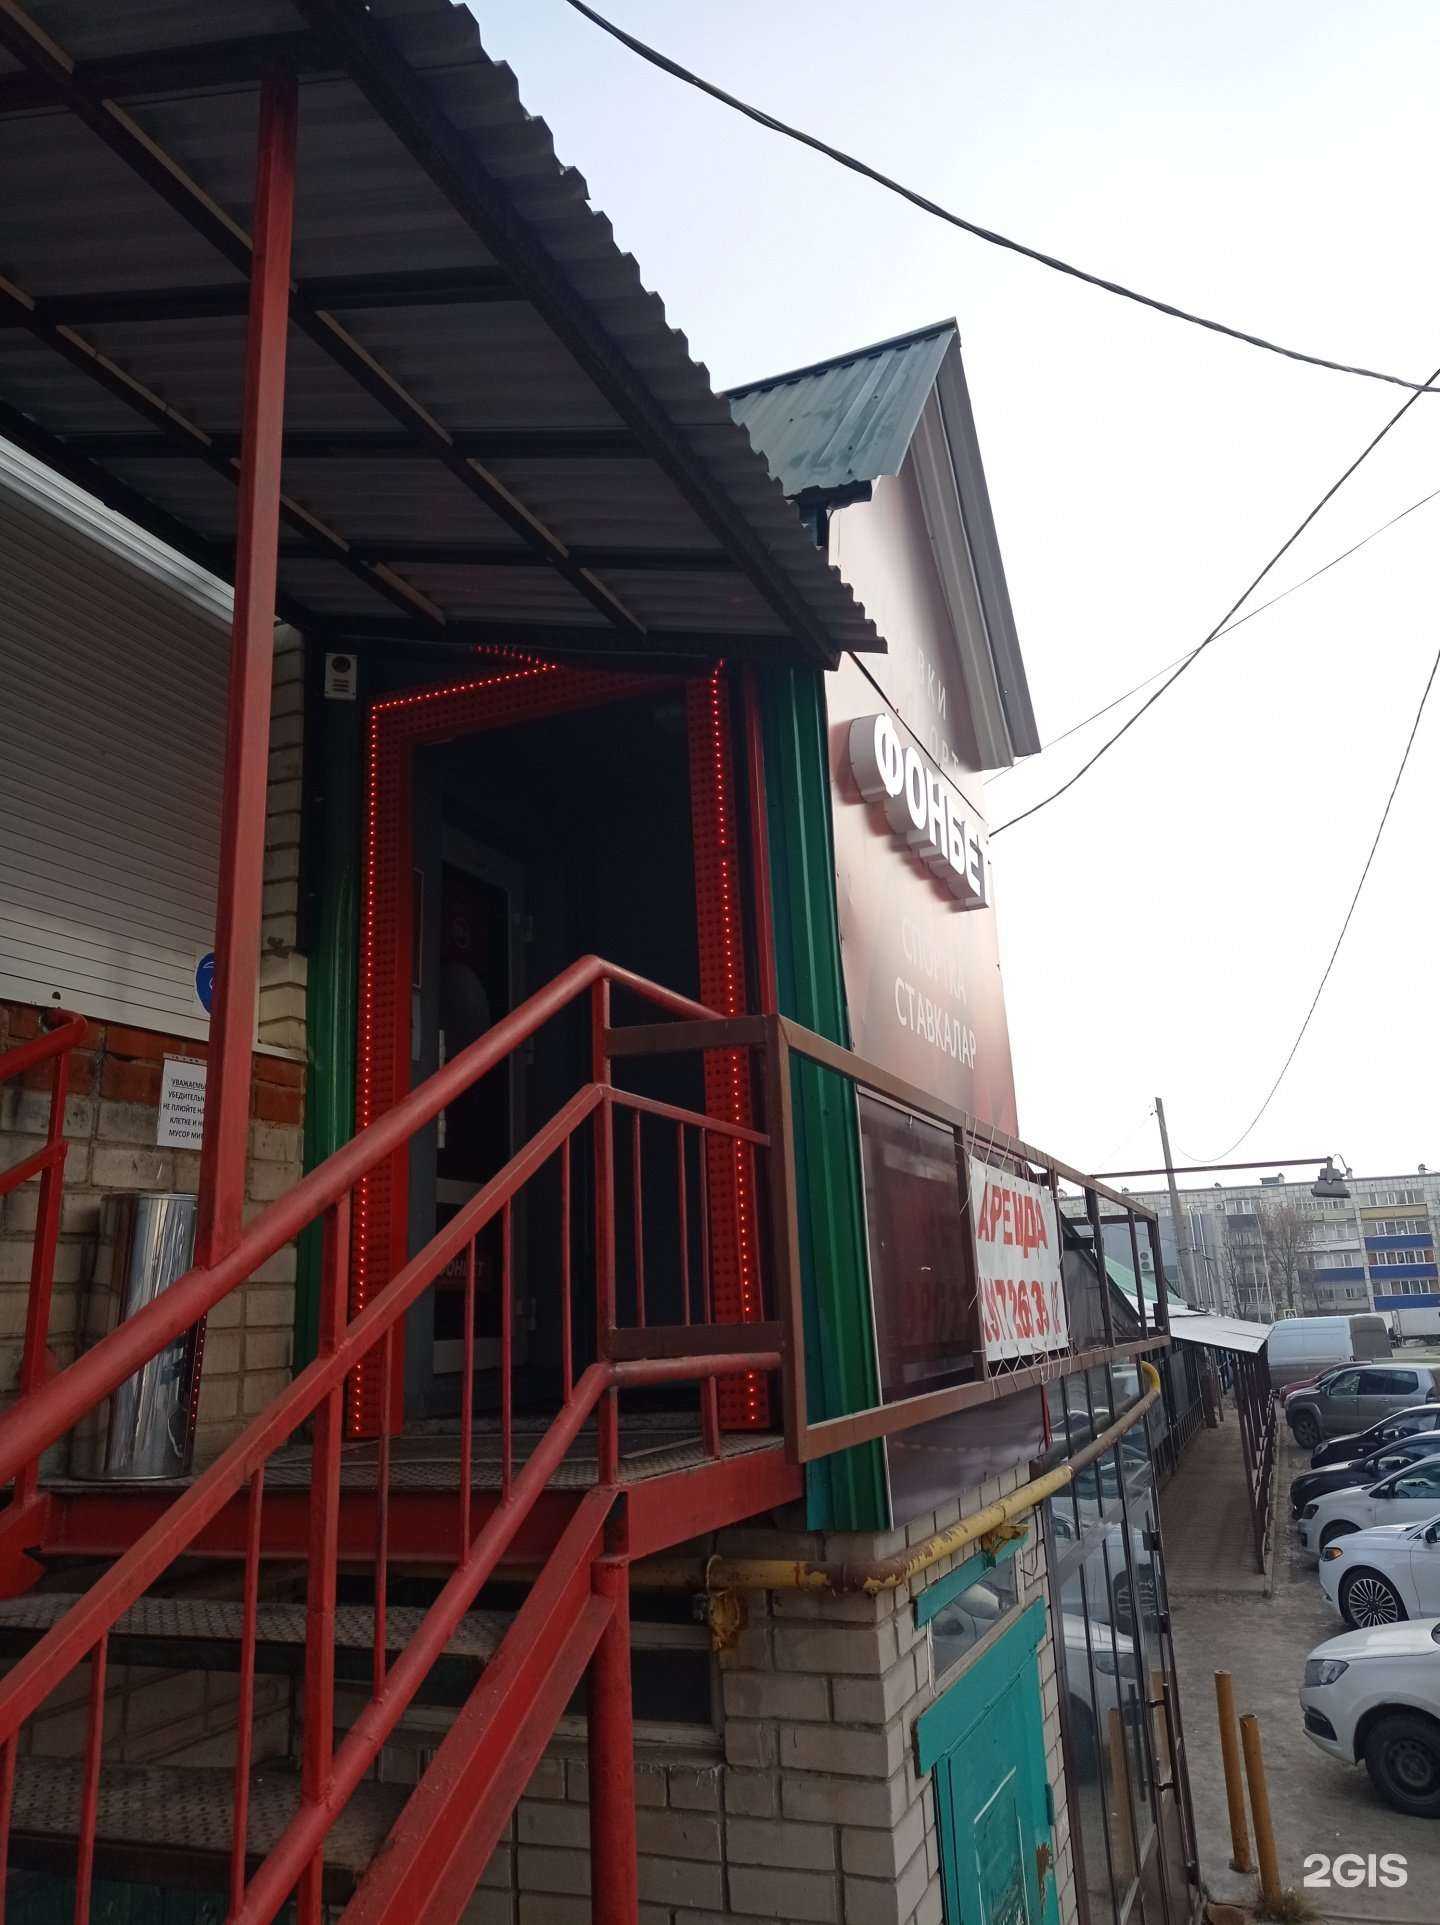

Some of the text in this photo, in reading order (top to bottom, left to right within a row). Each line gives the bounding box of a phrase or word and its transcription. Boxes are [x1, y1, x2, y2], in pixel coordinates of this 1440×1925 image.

[895, 975, 977, 1073] СТАВКАЛАР
[162, 1103, 170, 1111] НЕ
[169, 1117, 191, 1126] КЛЕТКЕ
[168, 1129, 190, 1138] МУСОР
